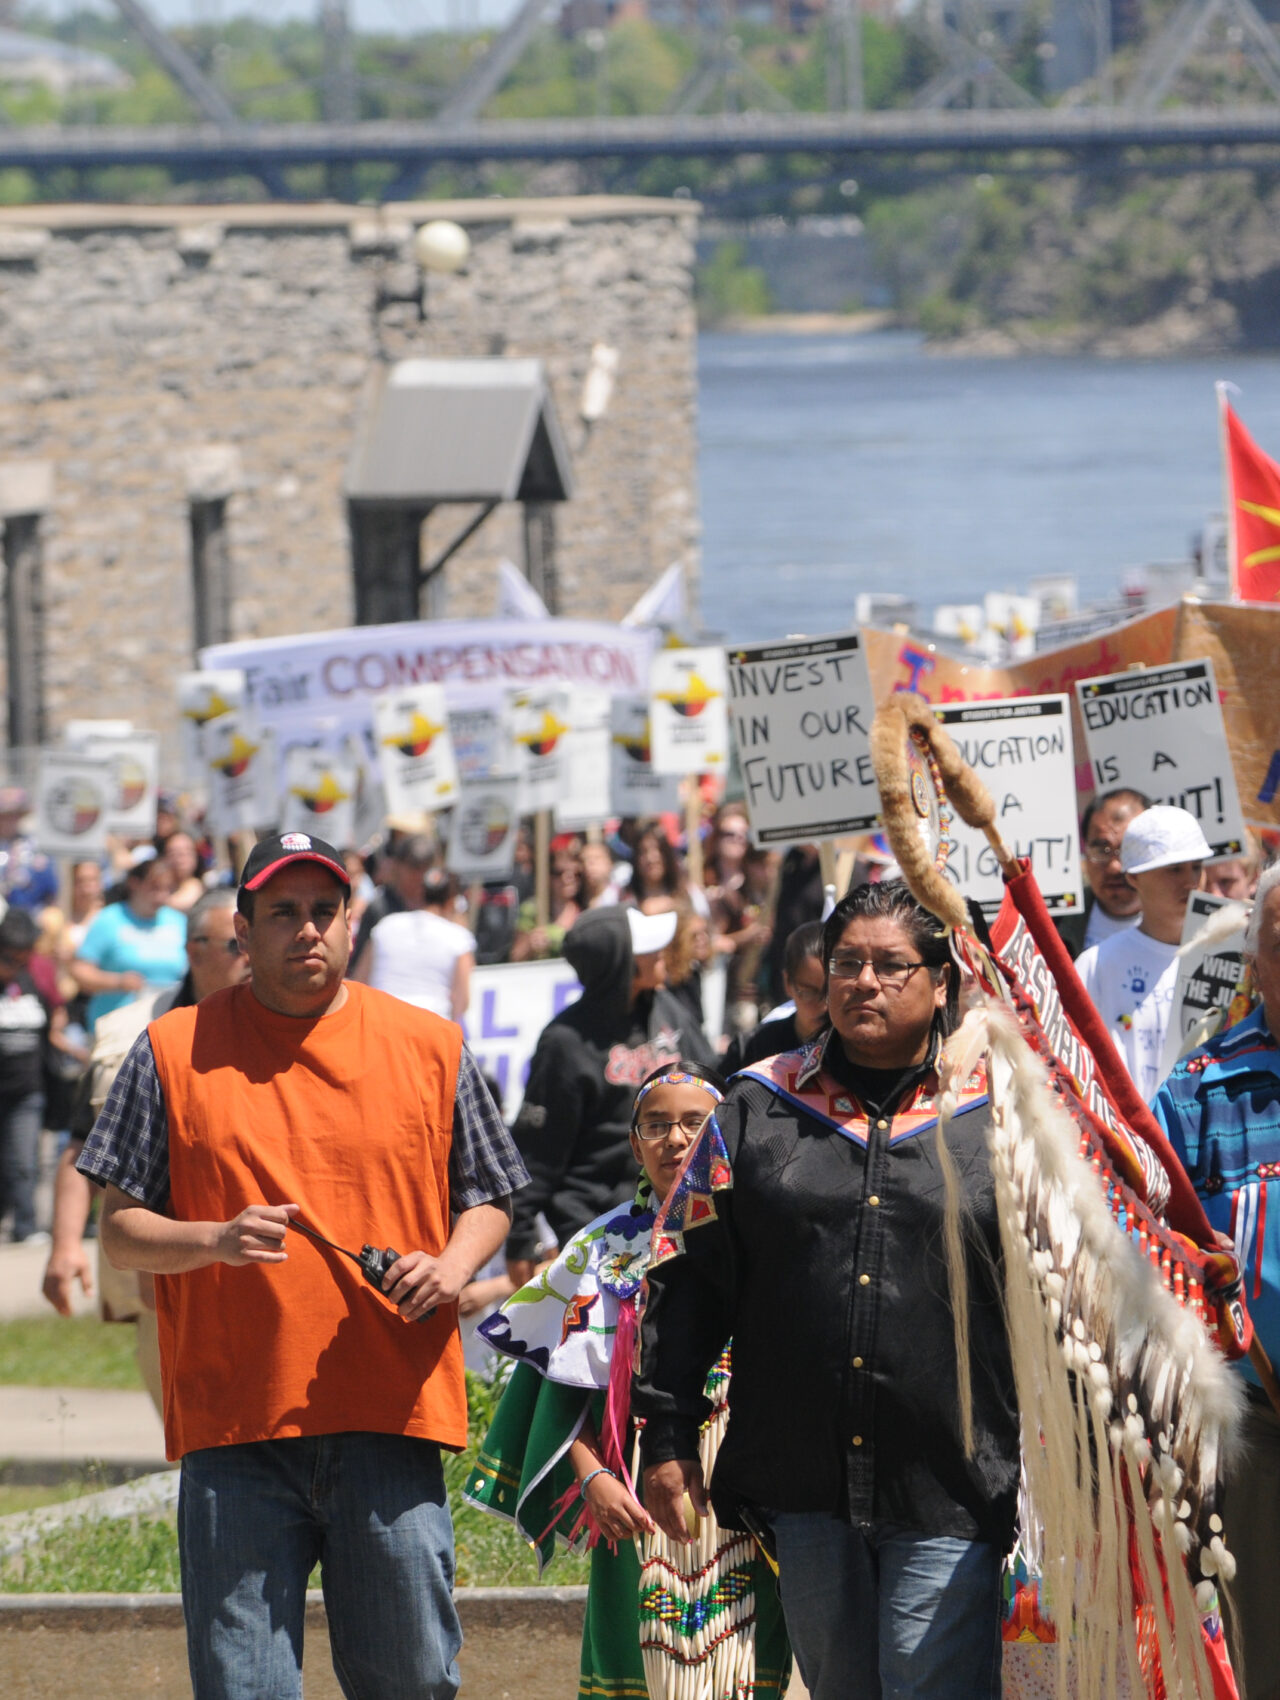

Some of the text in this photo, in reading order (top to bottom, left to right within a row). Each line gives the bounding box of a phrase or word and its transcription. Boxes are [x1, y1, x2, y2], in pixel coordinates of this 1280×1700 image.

[321, 641, 640, 698] COMPENSATION
[729, 654, 856, 698] INVEST
[739, 715, 769, 747] IN
[801, 705, 868, 738] OUR
[1084, 681, 1213, 731] EDUCATION
[951, 725, 1064, 768] UCATION
[1095, 751, 1178, 784] IS A
[744, 755, 875, 807] FUTURE
[1001, 793, 1023, 817] A
